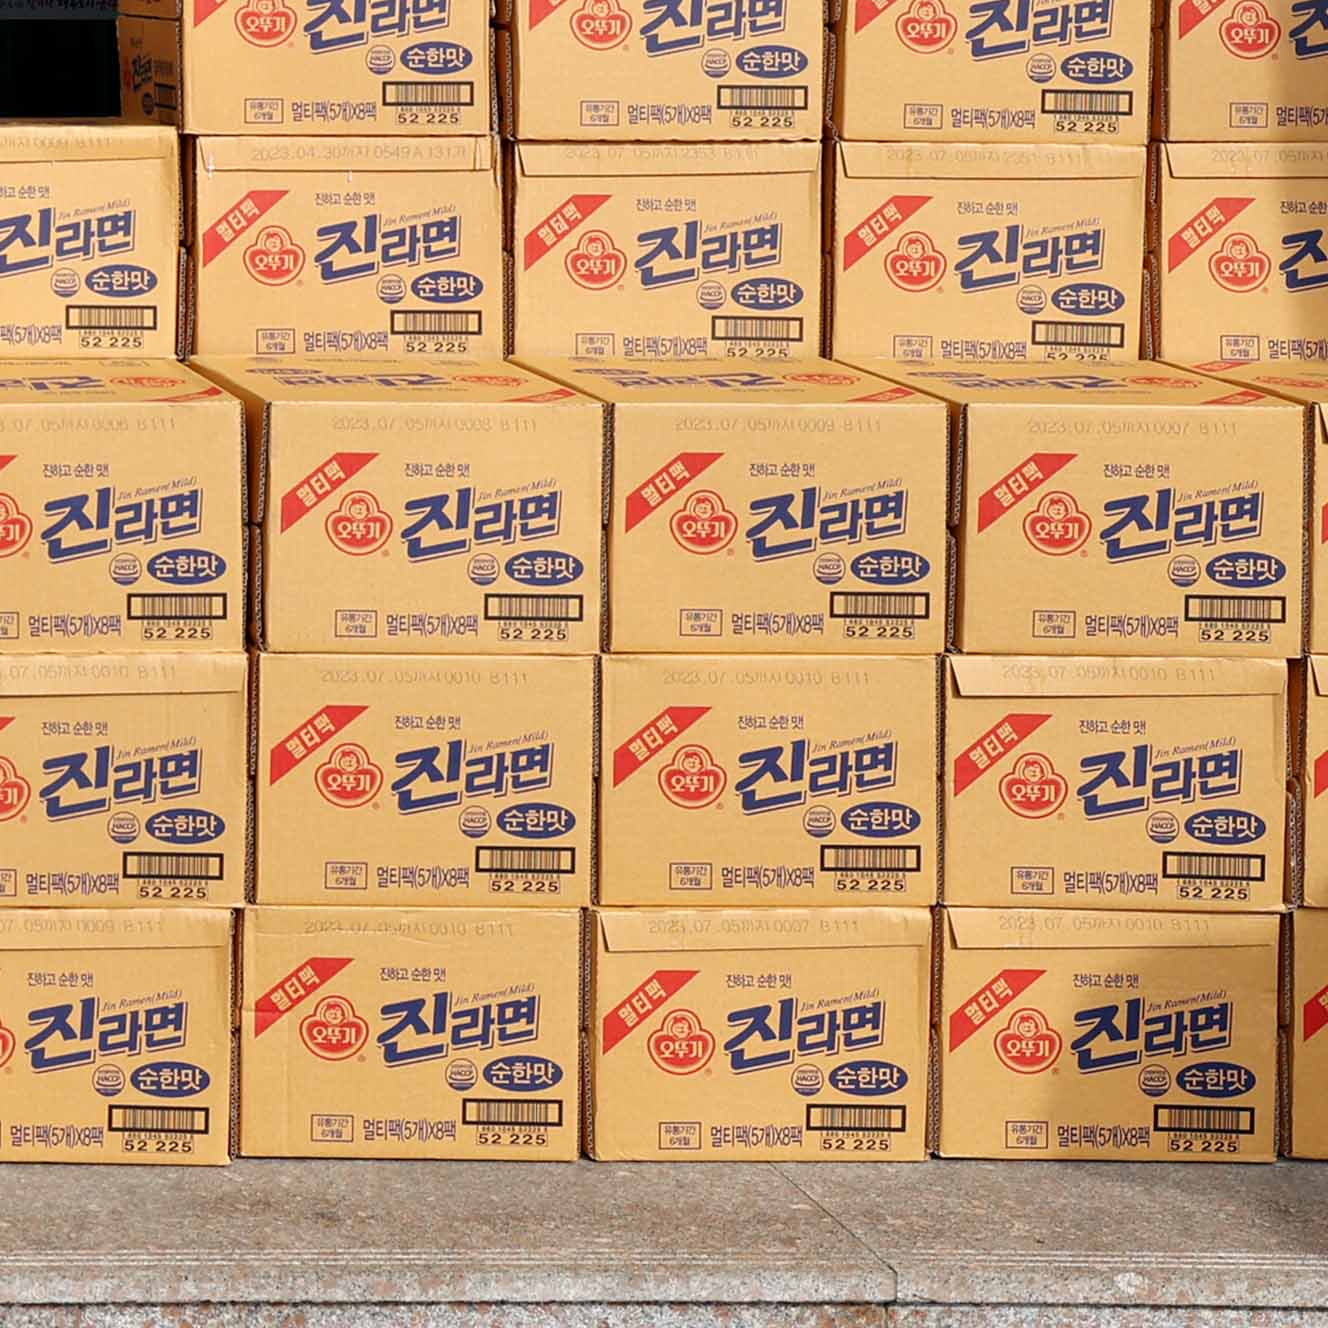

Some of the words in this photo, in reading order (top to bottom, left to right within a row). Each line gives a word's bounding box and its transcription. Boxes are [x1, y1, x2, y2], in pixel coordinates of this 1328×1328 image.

[1068, 58, 1126, 77] 순한맛
[417, 277, 474, 296] 순한맛
[635, 220, 782, 291] 진라면
[954, 225, 1104, 295] 진라면
[41, 485, 203, 564] 진라면
[337, 520, 380, 539] 오뚜기
[746, 485, 908, 563] 진라면
[1100, 486, 1264, 566] 진라면
[40, 745, 202, 822] 진라면
[327, 772, 370, 792] 오뚜기
[735, 739, 898, 815] 진라면
[1077, 744, 1242, 823] 진라면
[837, 880, 858, 890] 52
[868, 880, 904, 890] 225
[24, 997, 188, 1075] 진라면
[660, 1033, 703, 1052] 오뚜기
[1071, 998, 1233, 1076] 진라면
[491, 1063, 554, 1083] 순한맛
